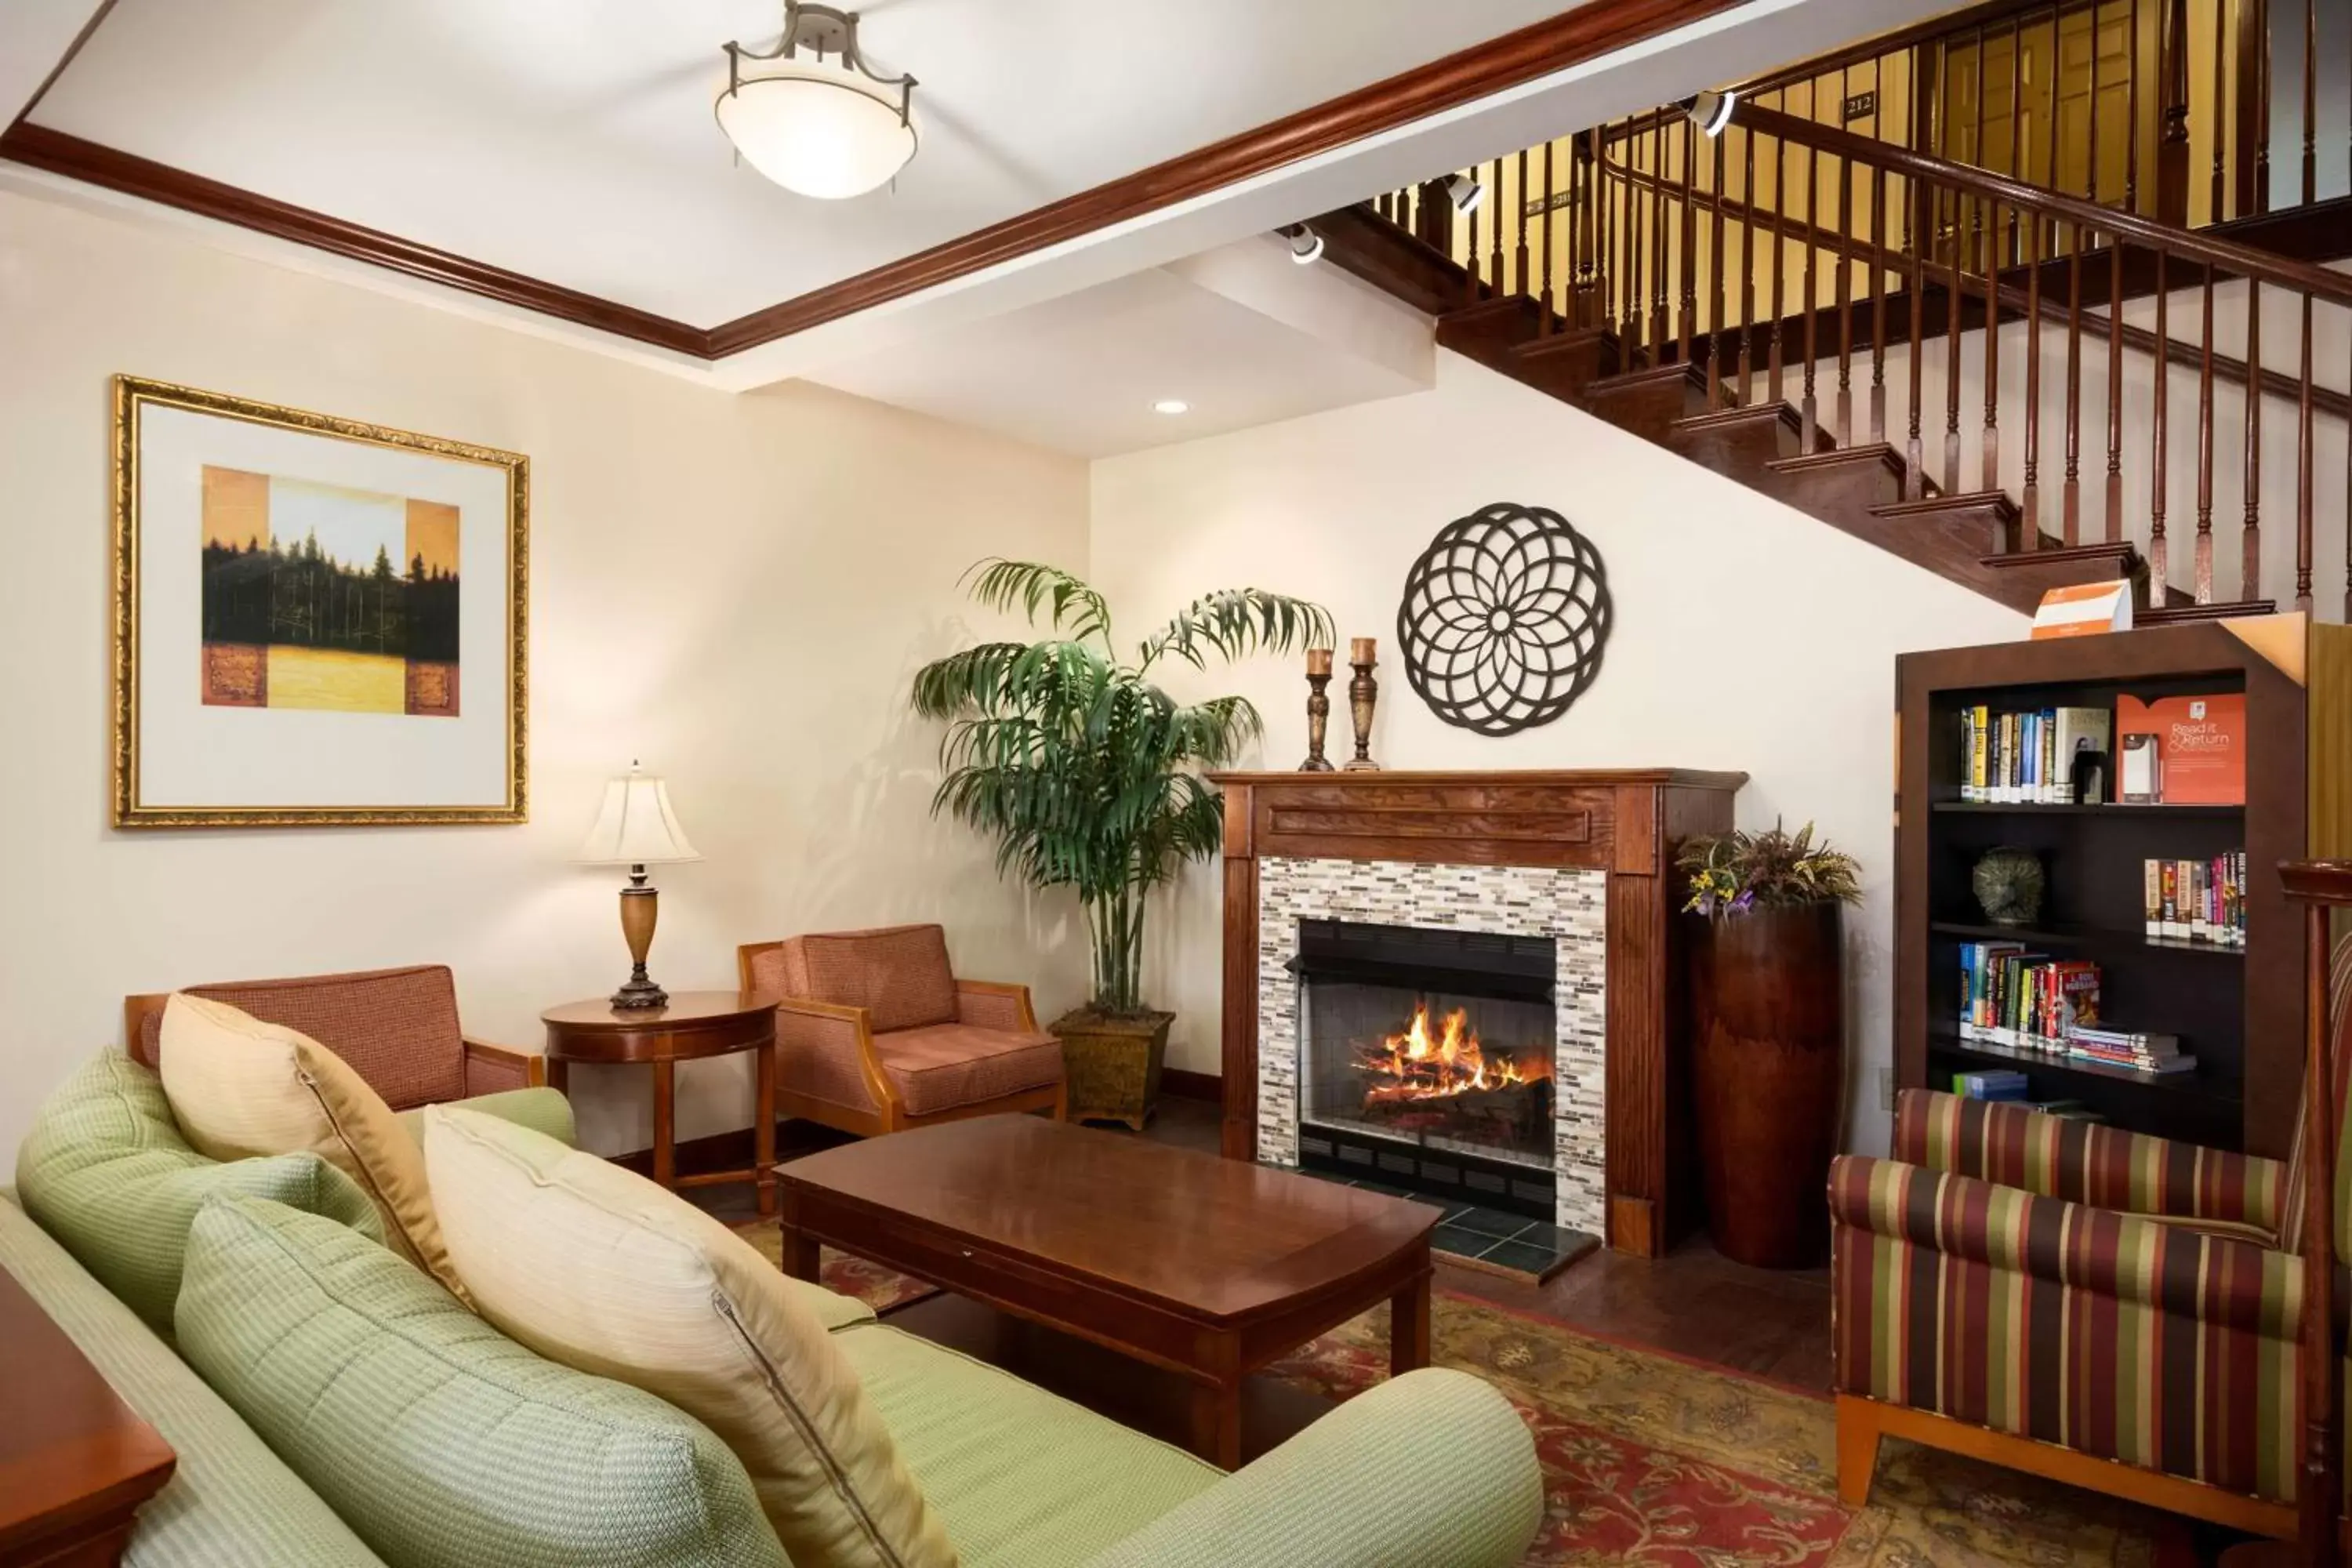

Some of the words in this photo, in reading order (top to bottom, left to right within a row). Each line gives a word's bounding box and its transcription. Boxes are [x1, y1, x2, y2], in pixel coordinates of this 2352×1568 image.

[1848, 96, 1871, 114] 212
[2172, 722, 2206, 735] Read
[2208, 722, 2218, 734] it
[2180, 734, 2230, 746] Return
